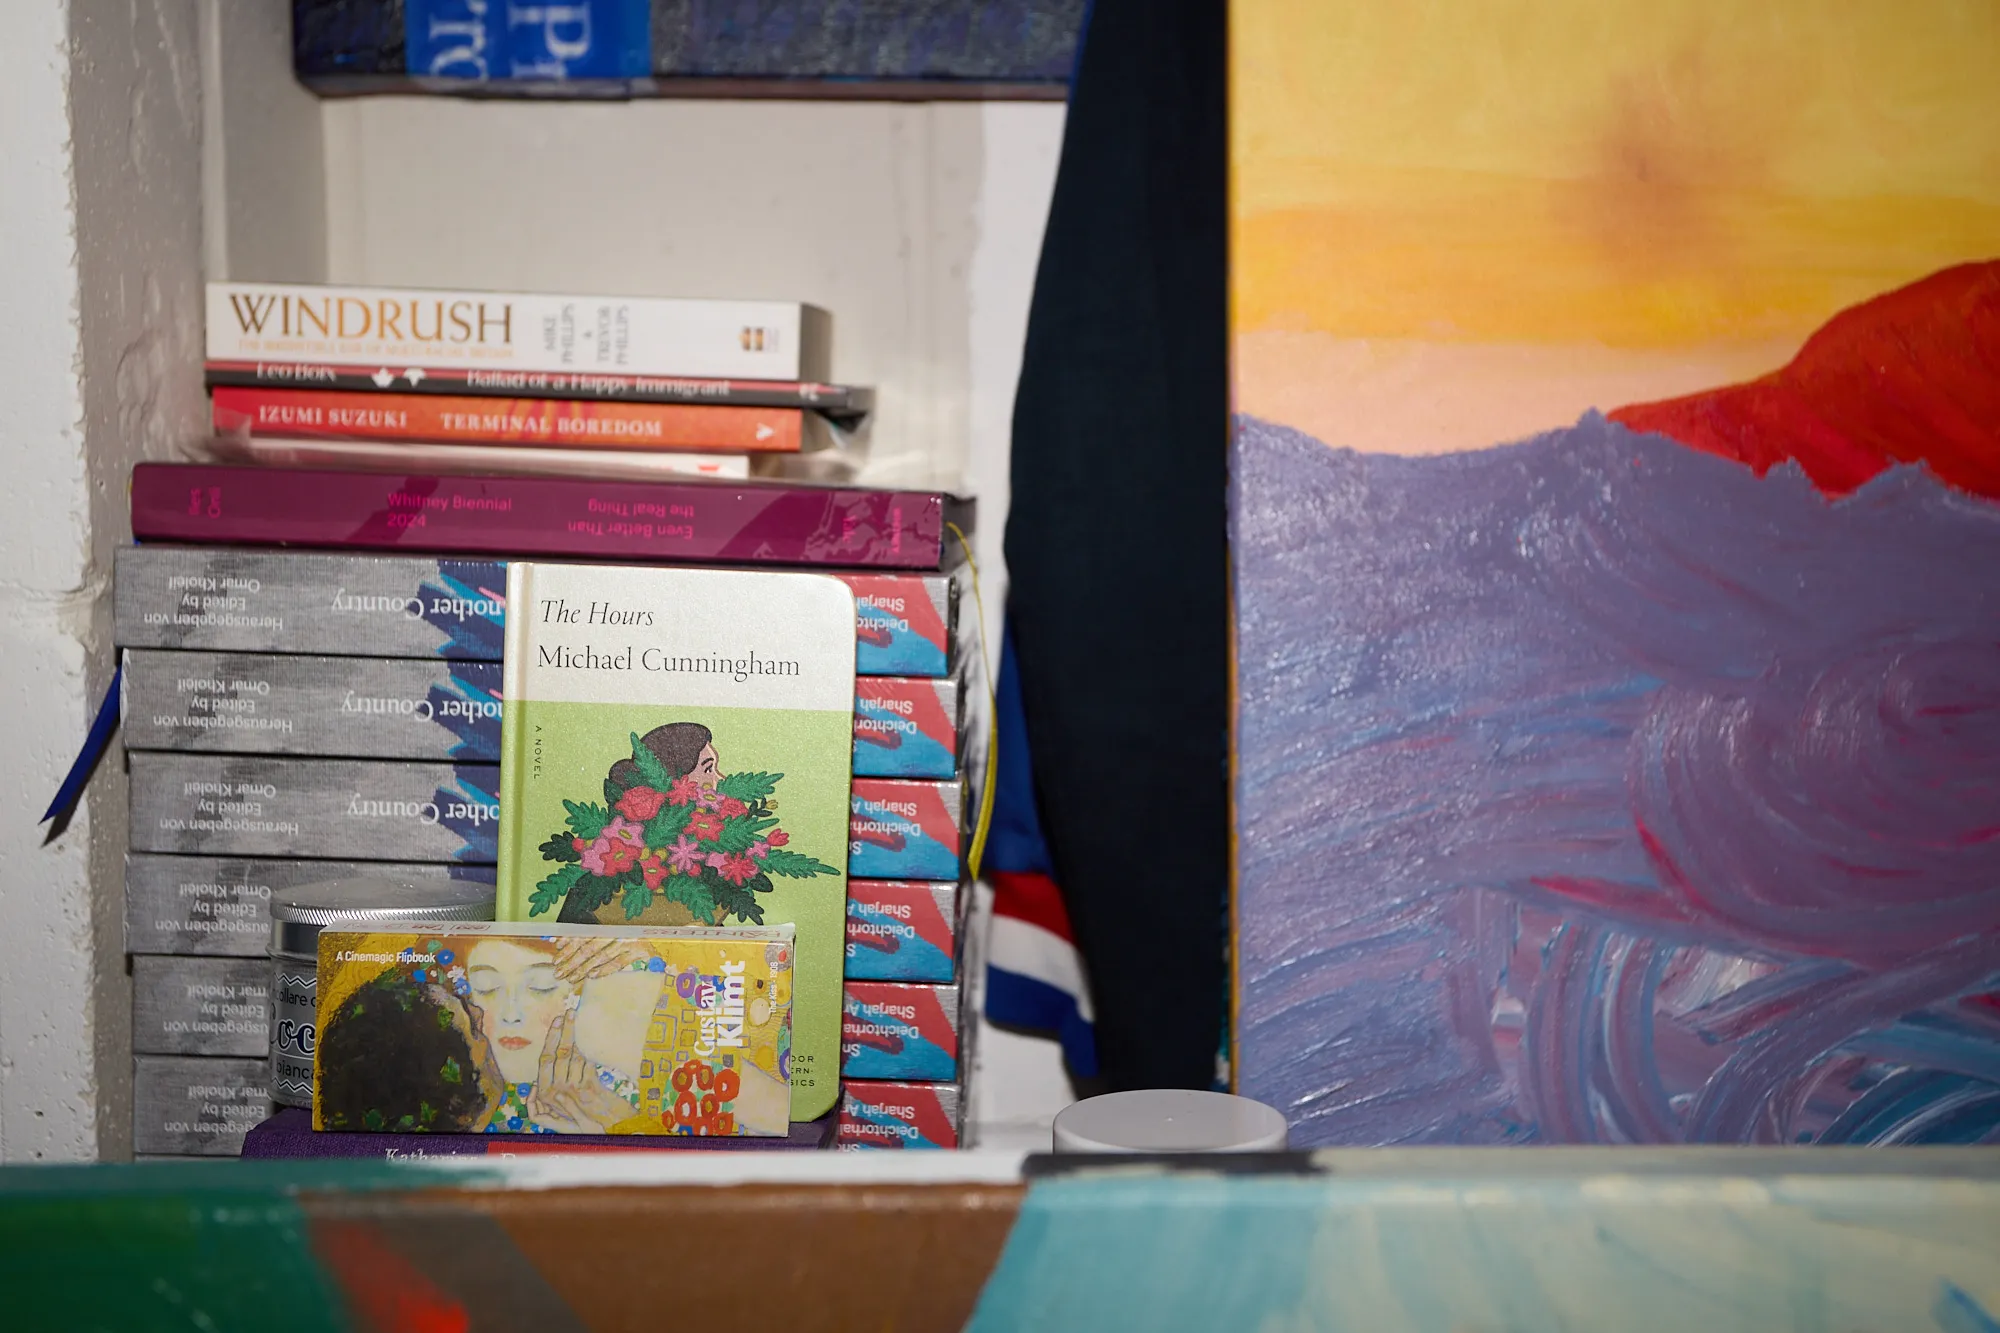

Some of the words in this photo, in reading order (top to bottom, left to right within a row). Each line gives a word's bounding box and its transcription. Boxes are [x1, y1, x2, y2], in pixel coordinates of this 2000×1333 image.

[229, 293, 512, 343] WINDRUSH
[467, 370, 525, 389] Ballad
[528, 373, 548, 390] of
[552, 378, 566, 391] a
[571, 374, 629, 396] Happy
[635, 377, 730, 397] Immigrant
[259, 405, 323, 425] IZUMI
[328, 408, 407, 429] SUZUKI
[440, 412, 550, 434] TERMINAL
[557, 416, 662, 436] BOREDOM
[387, 492, 448, 512] Whitney
[453, 494, 512, 512] Biennial
[588, 497, 629, 517] Thing
[633, 502, 666, 518] Real
[670, 503, 694, 518] the
[387, 511, 427, 528] 2024
[567, 520, 604, 537] Than
[608, 522, 653, 539] Better
[657, 523, 694, 540] Even
[169, 575, 216, 592] Kholeif
[219, 577, 260, 594] Omar
[182, 592, 199, 608] by
[203, 596, 246, 610] Edited
[331, 587, 424, 620] Country
[430, 597, 502, 622] nother
[541, 599, 581, 624] The
[588, 601, 654, 627] Hours
[144, 612, 169, 625] von
[173, 611, 283, 631] Herausgegeben
[538, 644, 632, 670] Michael
[641, 648, 800, 683] Cunningham
[177, 677, 225, 693] Kholeif
[228, 679, 270, 696] Omar
[191, 695, 208, 712] by
[212, 698, 255, 714] Edited
[341, 689, 434, 722] Country
[860, 697, 914, 715] Sharjah
[153, 714, 179, 727] von
[183, 714, 293, 734] Herausgegeben
[535, 725, 542, 733] A
[534, 738, 542, 780] NOVEL
[184, 781, 232, 797] Kholeif
[236, 782, 276, 799] Omar
[198, 798, 215, 815] by
[218, 801, 262, 817] Edited
[347, 792, 440, 825] Country
[445, 801, 500, 827] other
[864, 799, 917, 817] Sharjah
[160, 818, 185, 830] von
[189, 818, 299, 837] Herausgegeben
[851, 820, 921, 837] Deichtorh
[179, 883, 227, 898] Kholeif
[231, 885, 272, 901] Omar
[193, 899, 210, 916] by
[213, 902, 257, 918] Edited
[858, 901, 912, 919] Sharjah
[155, 920, 181, 932] von
[185, 920, 271, 934] ausgegeben
[847, 922, 916, 939] Deichtorh
[336, 950, 343, 962] A
[345, 950, 394, 964] Cinemagic
[396, 952, 436, 965] Flipbook
[769, 961, 779, 978] 1908
[238, 985, 269, 999] mar
[277, 988, 308, 1007] ollare
[768, 983, 777, 1000] Kiss
[201, 1002, 218, 1018] by
[221, 1004, 265, 1019] Edited
[716, 960, 746, 1048] Klimt
[768, 1000, 777, 1013] The
[843, 1002, 860, 1016] Ar
[863, 1002, 915, 1020] Sharjah
[163, 1020, 190, 1032] von
[694, 980, 717, 1057] Gustav
[192, 1020, 268, 1035] usgegeben
[843, 1024, 919, 1039] Deichtorha
[188, 1085, 236, 1100] Kholeif
[239, 1085, 269, 1100] mar
[201, 1102, 219, 1118] by
[222, 1103, 266, 1118] Edited
[842, 1102, 860, 1117] Ar
[863, 1102, 915, 1119] Sharjah
[164, 1121, 190, 1133] von
[194, 1121, 257, 1135] gegeben
